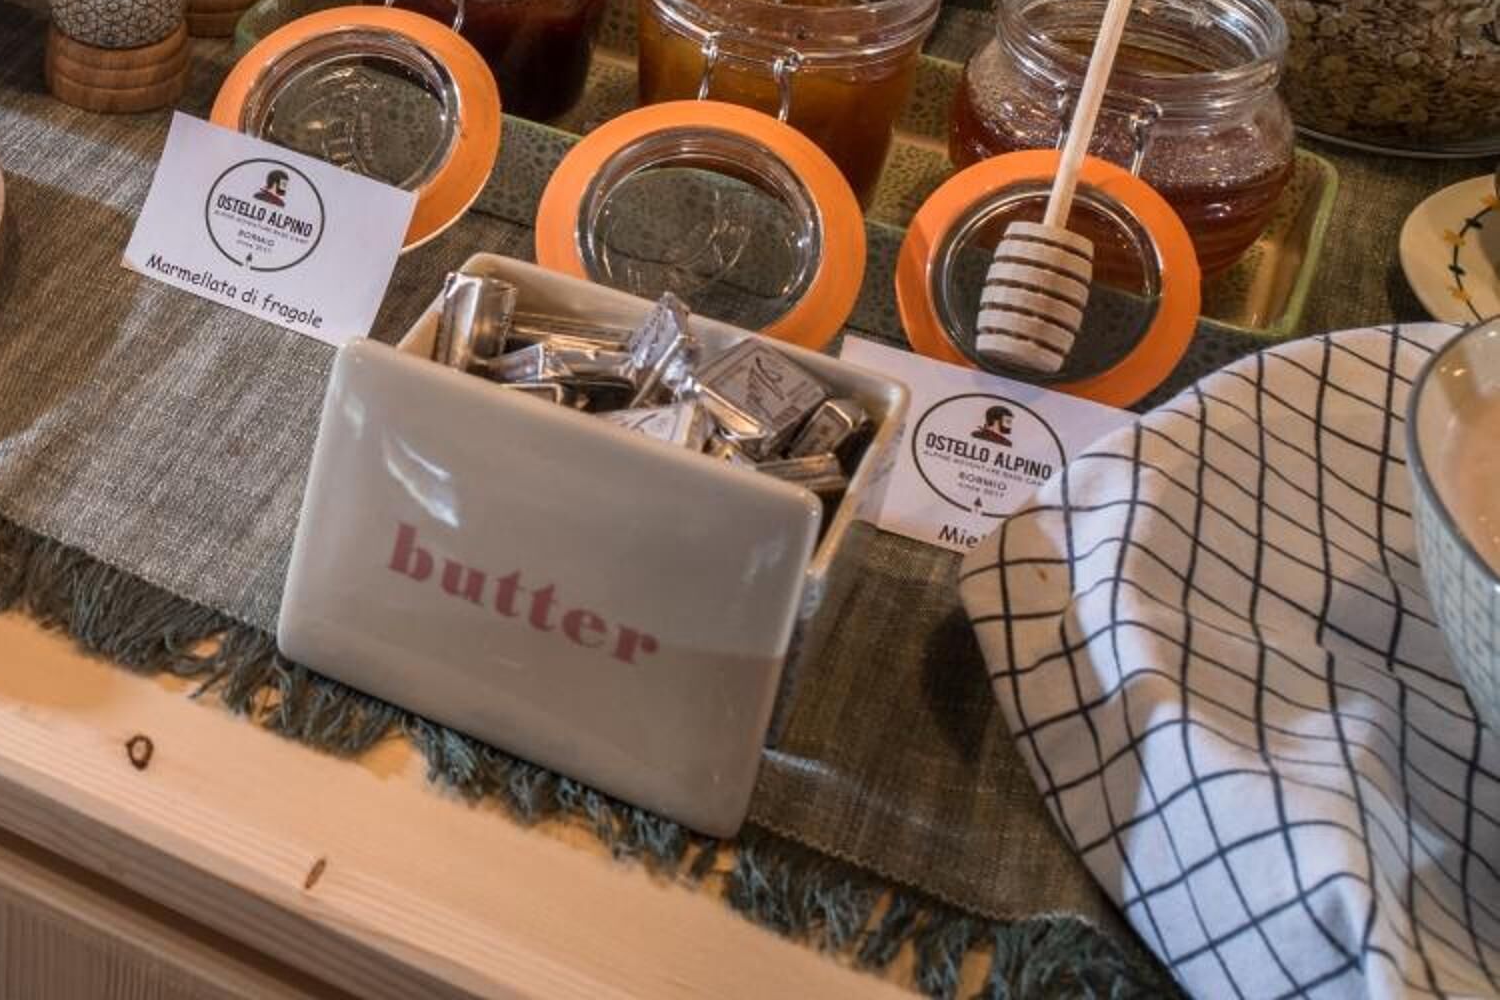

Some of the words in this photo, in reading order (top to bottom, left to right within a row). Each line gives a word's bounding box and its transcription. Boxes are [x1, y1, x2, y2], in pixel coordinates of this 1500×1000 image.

[217, 193, 266, 221] OSTELLO
[267, 211, 313, 237] ALPINO
[145, 254, 237, 299] Marmellata
[241, 287, 259, 305] di
[261, 294, 323, 329] fragole
[925, 432, 990, 463] OSTELLO
[994, 452, 1052, 481] ALPINO
[959, 471, 1007, 491] BORMIO
[937, 524, 987, 549] Mie
[388, 522, 660, 665] butter
